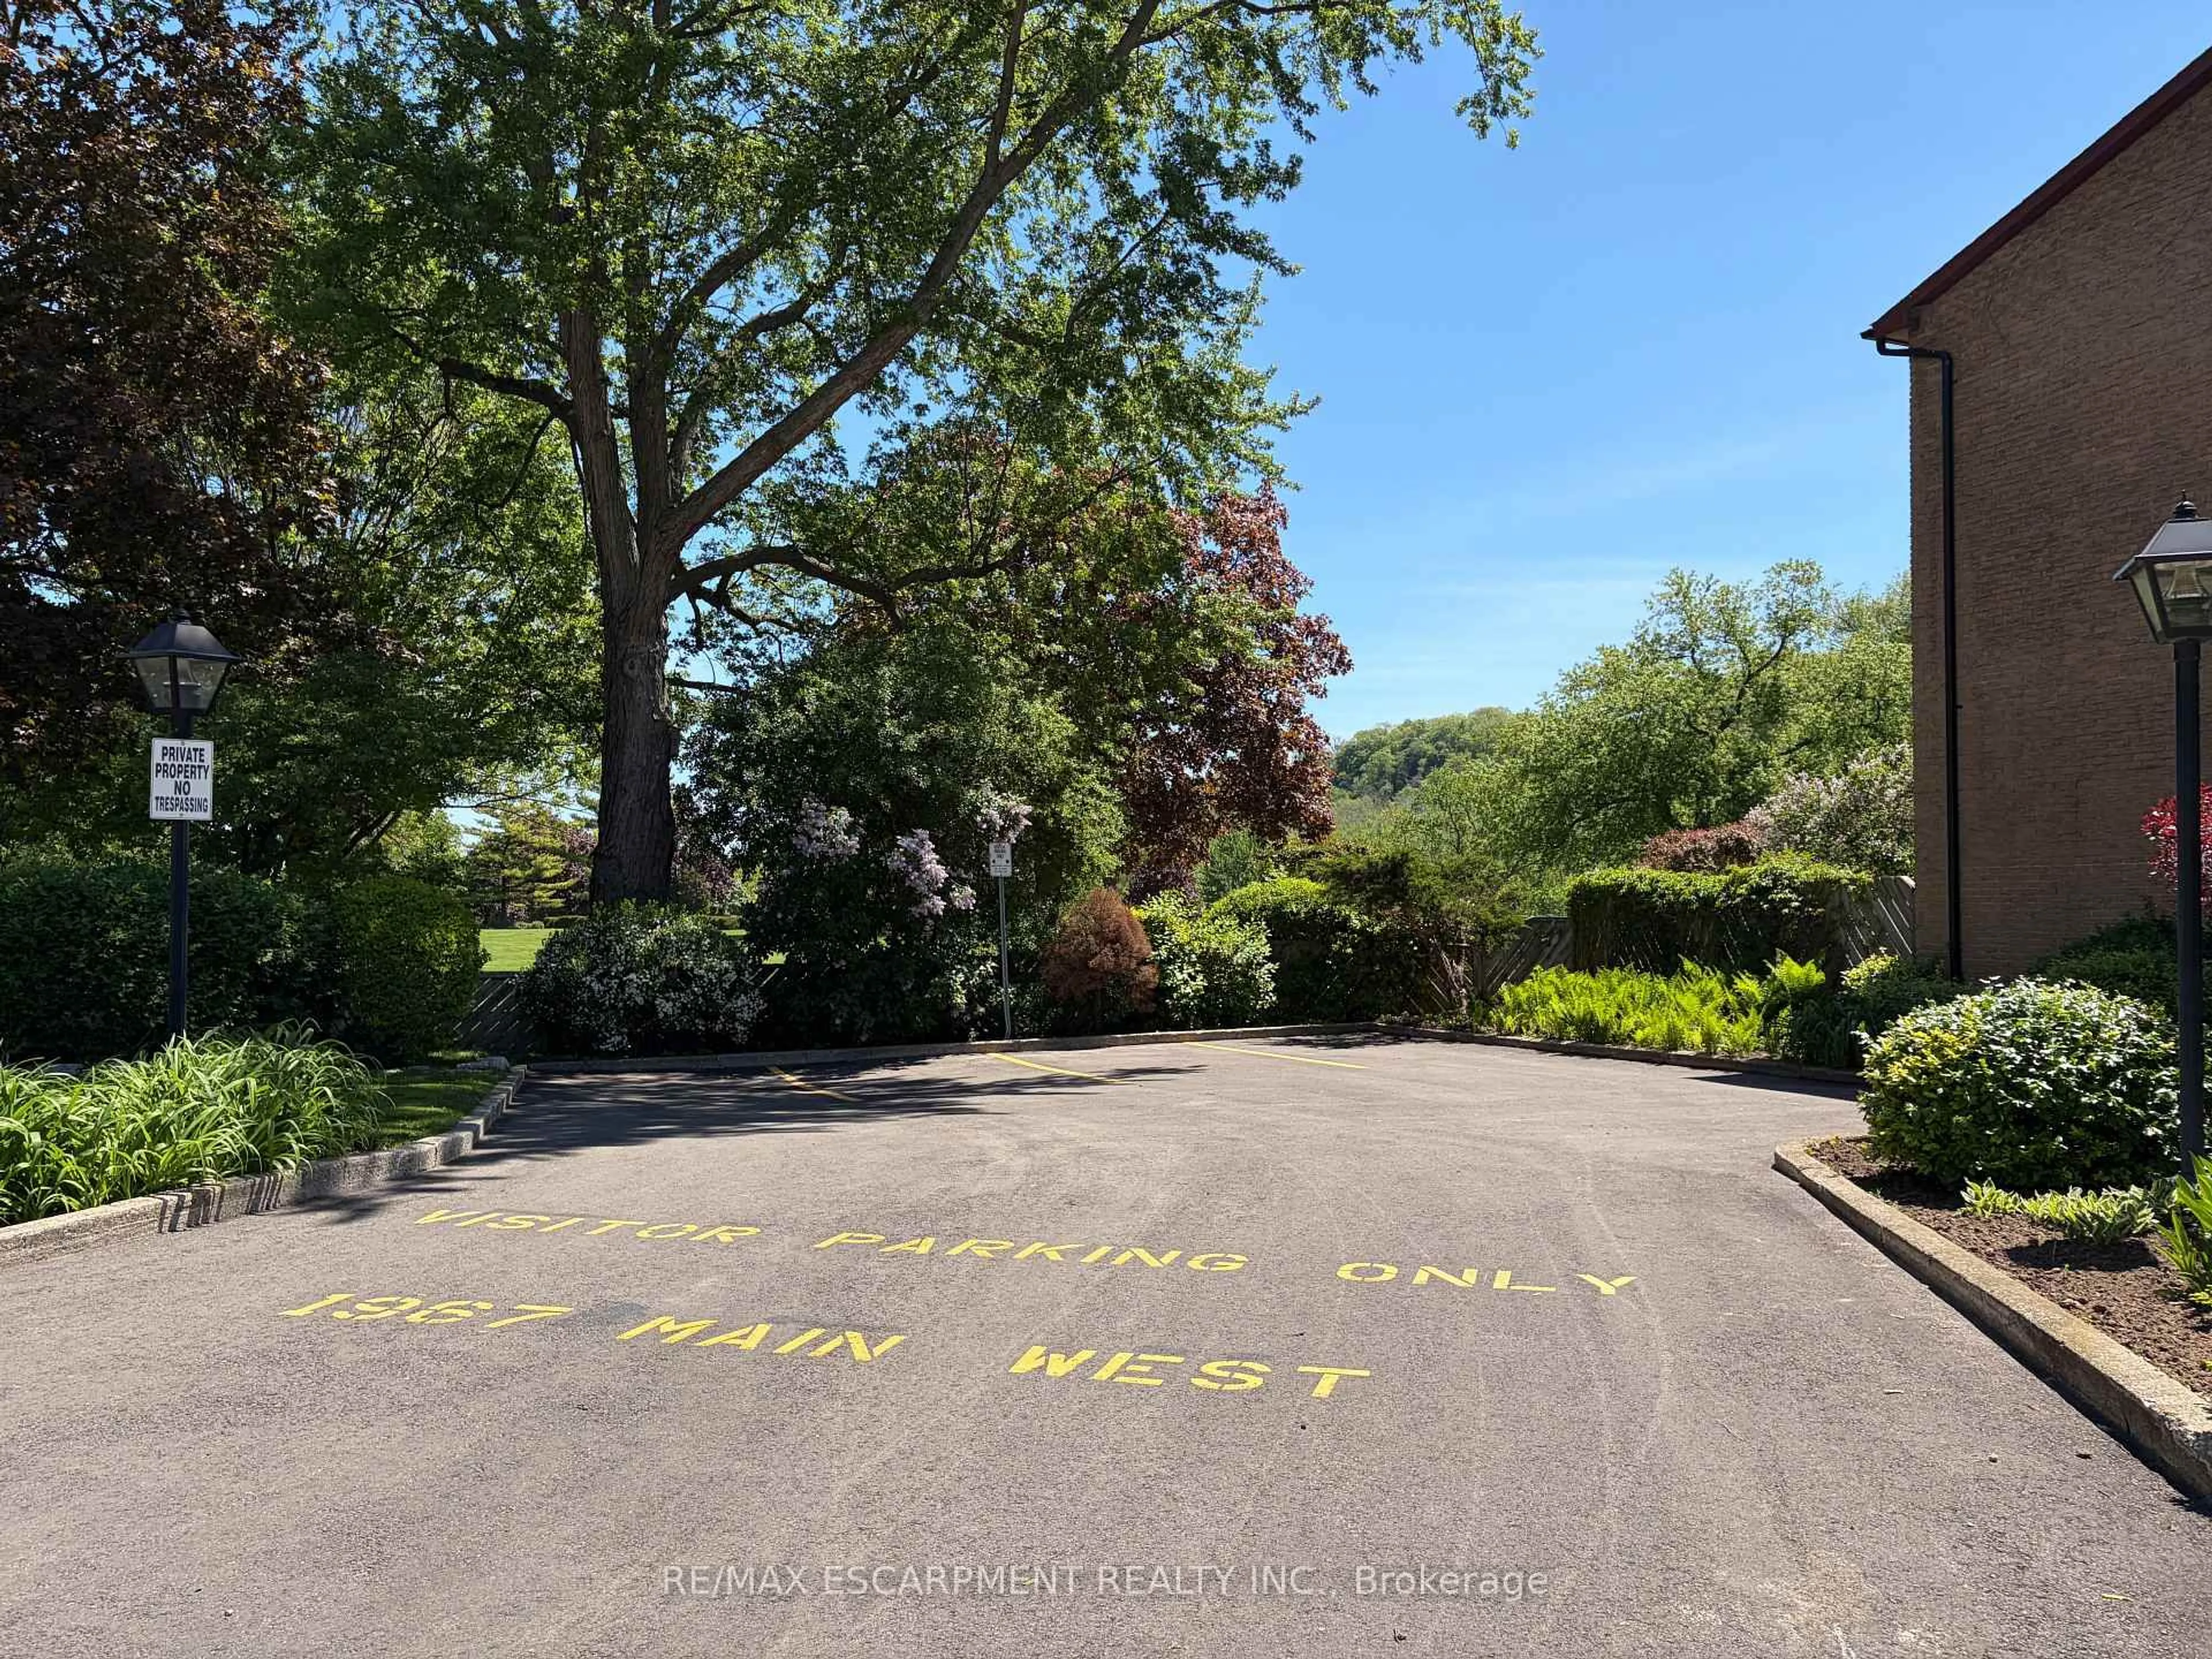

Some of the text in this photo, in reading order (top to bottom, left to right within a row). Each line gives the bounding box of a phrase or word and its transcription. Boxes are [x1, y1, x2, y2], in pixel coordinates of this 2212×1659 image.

[162, 747, 204, 762] PRIVATE
[156, 763, 209, 779] PROPERTY
[175, 781, 191, 795] NO
[155, 796, 209, 812] TRESPASSING
[415, 1210, 1637, 1295] VISITOR PARKING ONLY
[279, 1293, 1370, 1398] 1967 MAIN WEST
